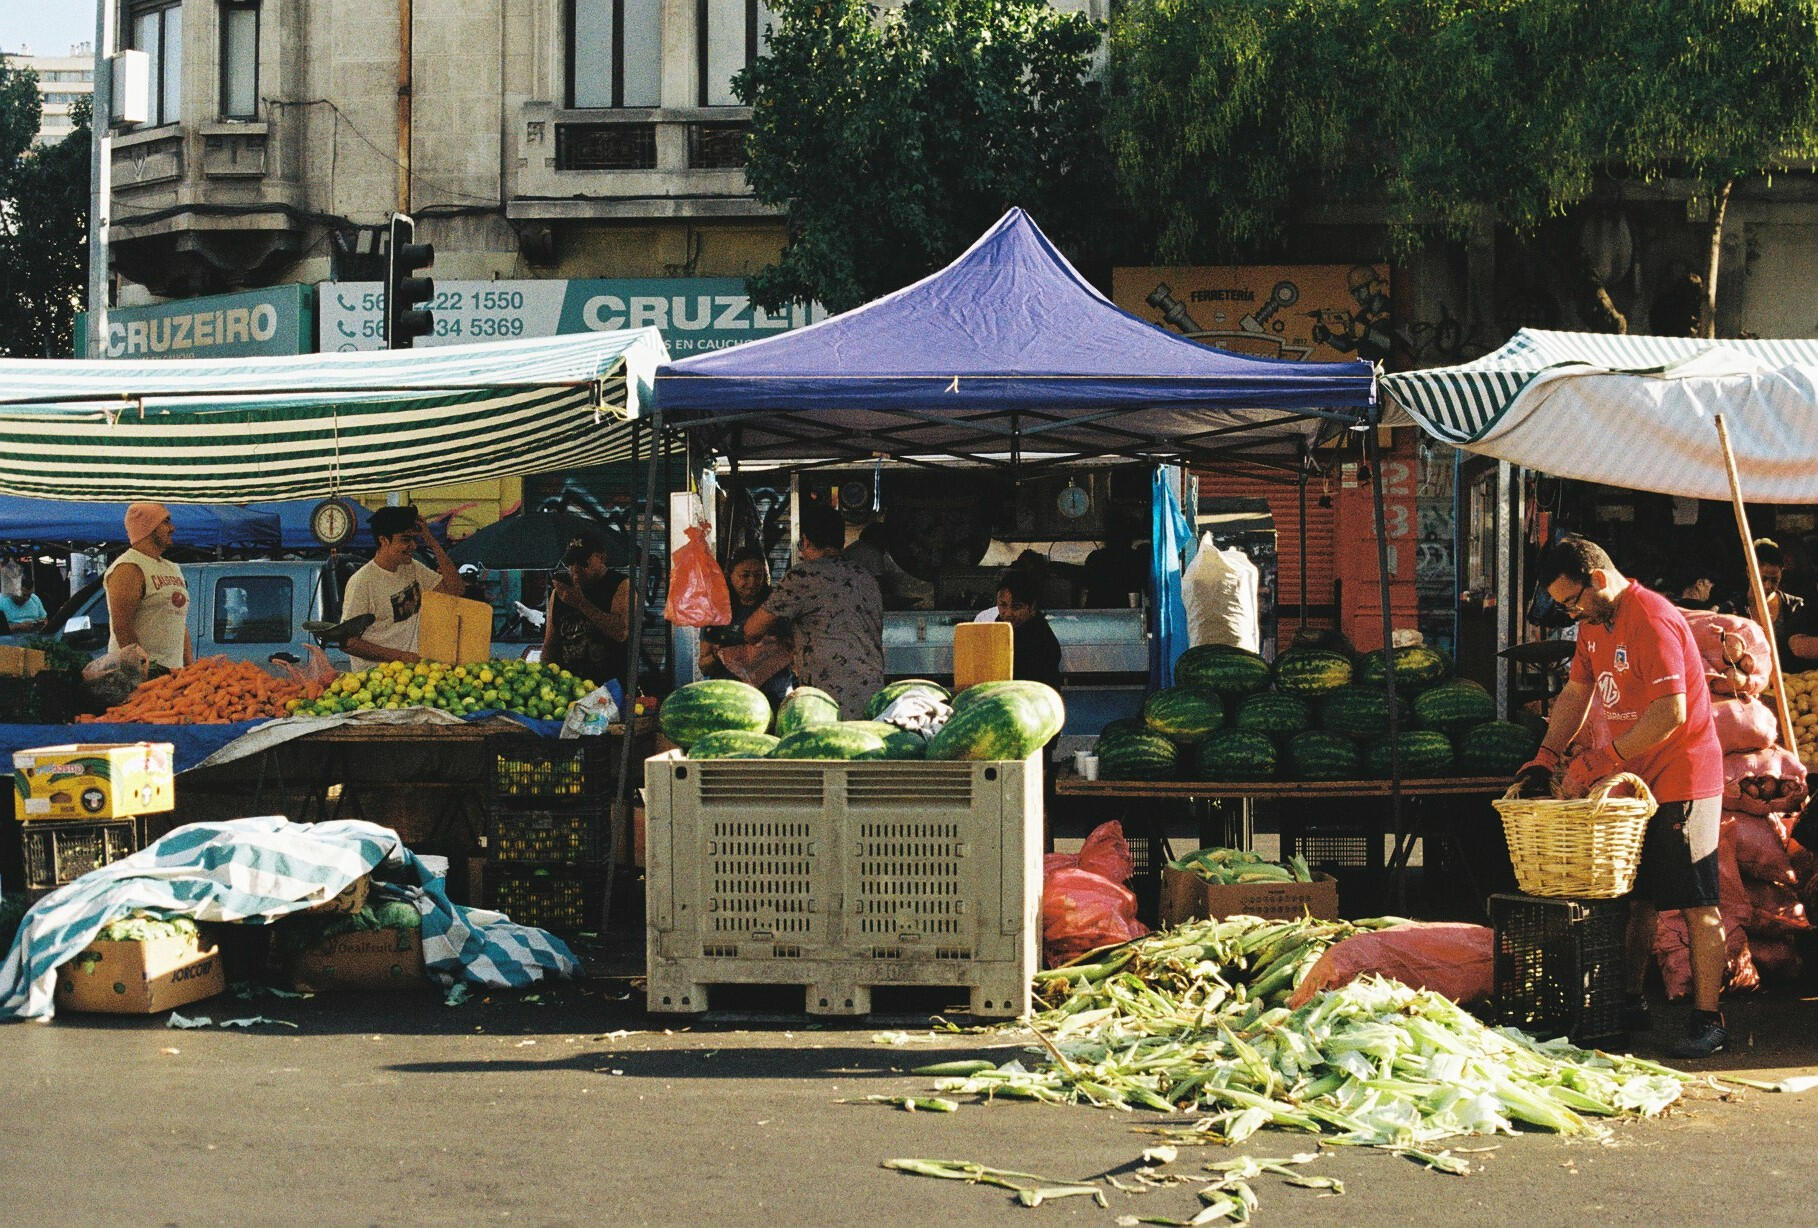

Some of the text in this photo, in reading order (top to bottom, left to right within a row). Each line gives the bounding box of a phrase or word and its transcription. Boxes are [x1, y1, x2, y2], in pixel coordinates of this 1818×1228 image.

[362, 293, 384, 311] 56
[471, 291, 524, 310] 1550
[107, 303, 278, 357] CRUZEIRO
[362, 319, 384, 337] 56
[470, 318, 524, 337] 5369
[675, 340, 694, 350] EN
